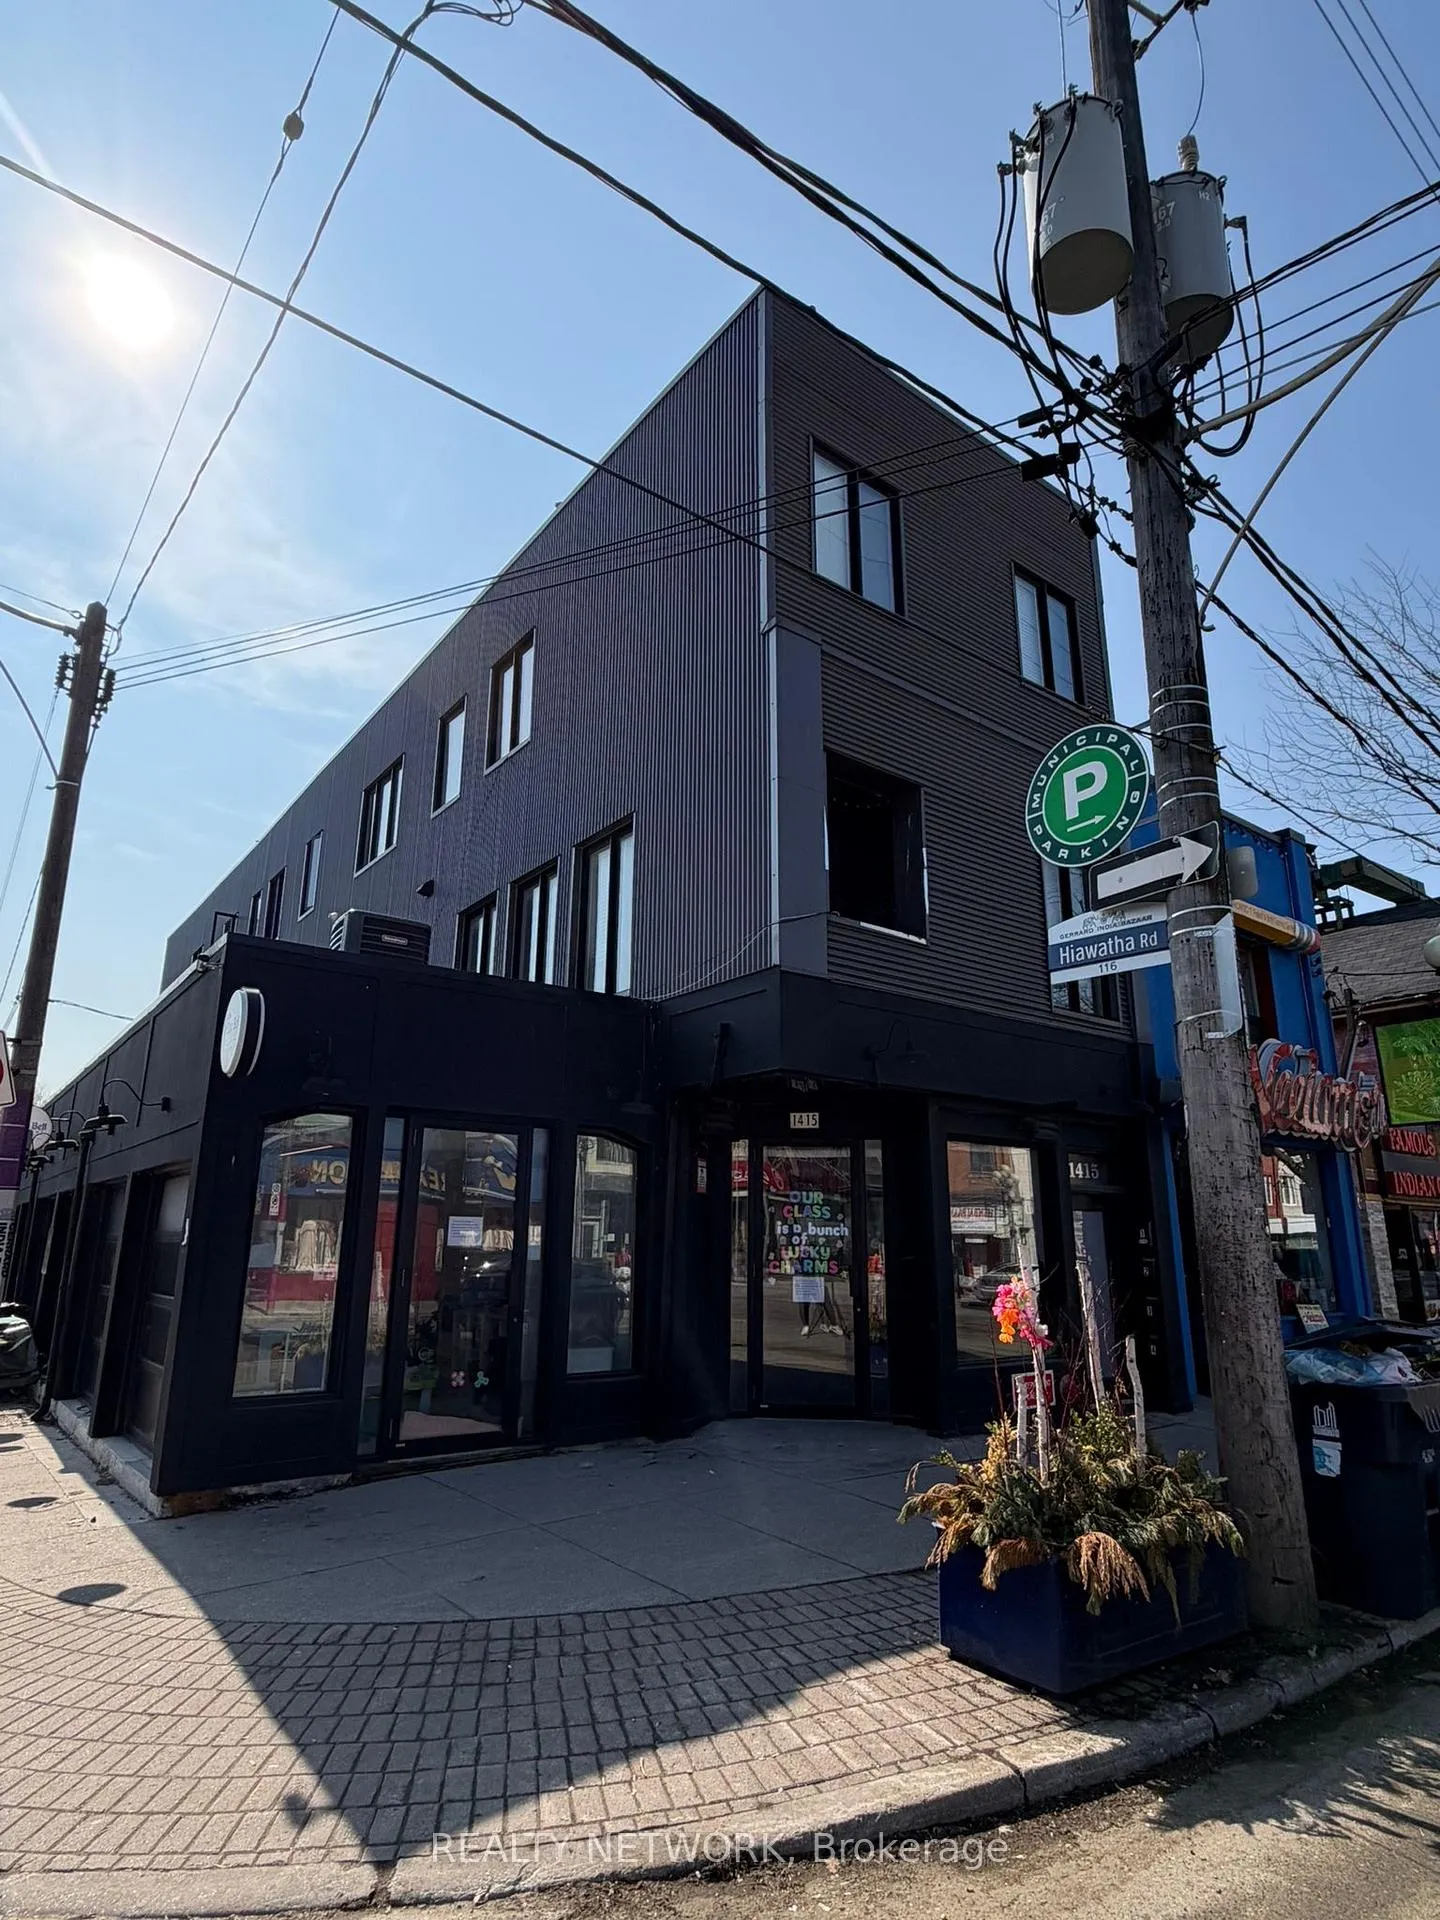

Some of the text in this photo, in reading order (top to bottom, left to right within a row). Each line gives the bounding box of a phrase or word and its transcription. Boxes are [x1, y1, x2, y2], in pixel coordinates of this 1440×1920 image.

[1031, 732, 1139, 809] MUNICIPAL
[1063, 761, 1108, 821] P
[1033, 790, 1141, 859] PARKING
[1059, 914, 1153, 940] GERRARD INDIA BAZAAR
[1059, 931, 1158, 965] Hiawatha Rd
[1098, 962, 1118, 974] 116
[793, 1114, 818, 1127] 1415
[1389, 1128, 1437, 1157] FAMOUS
[1068, 1161, 1100, 1179] 1415
[1394, 1171, 1437, 1197] INDIAN
[789, 1191, 824, 1206] OUR
[781, 1205, 831, 1219] CLASS
[776, 1221, 789, 1235] is
[807, 1222, 849, 1236] bunch
[791, 1232, 808, 1245] of
[768, 1259, 840, 1275] CHARMS
